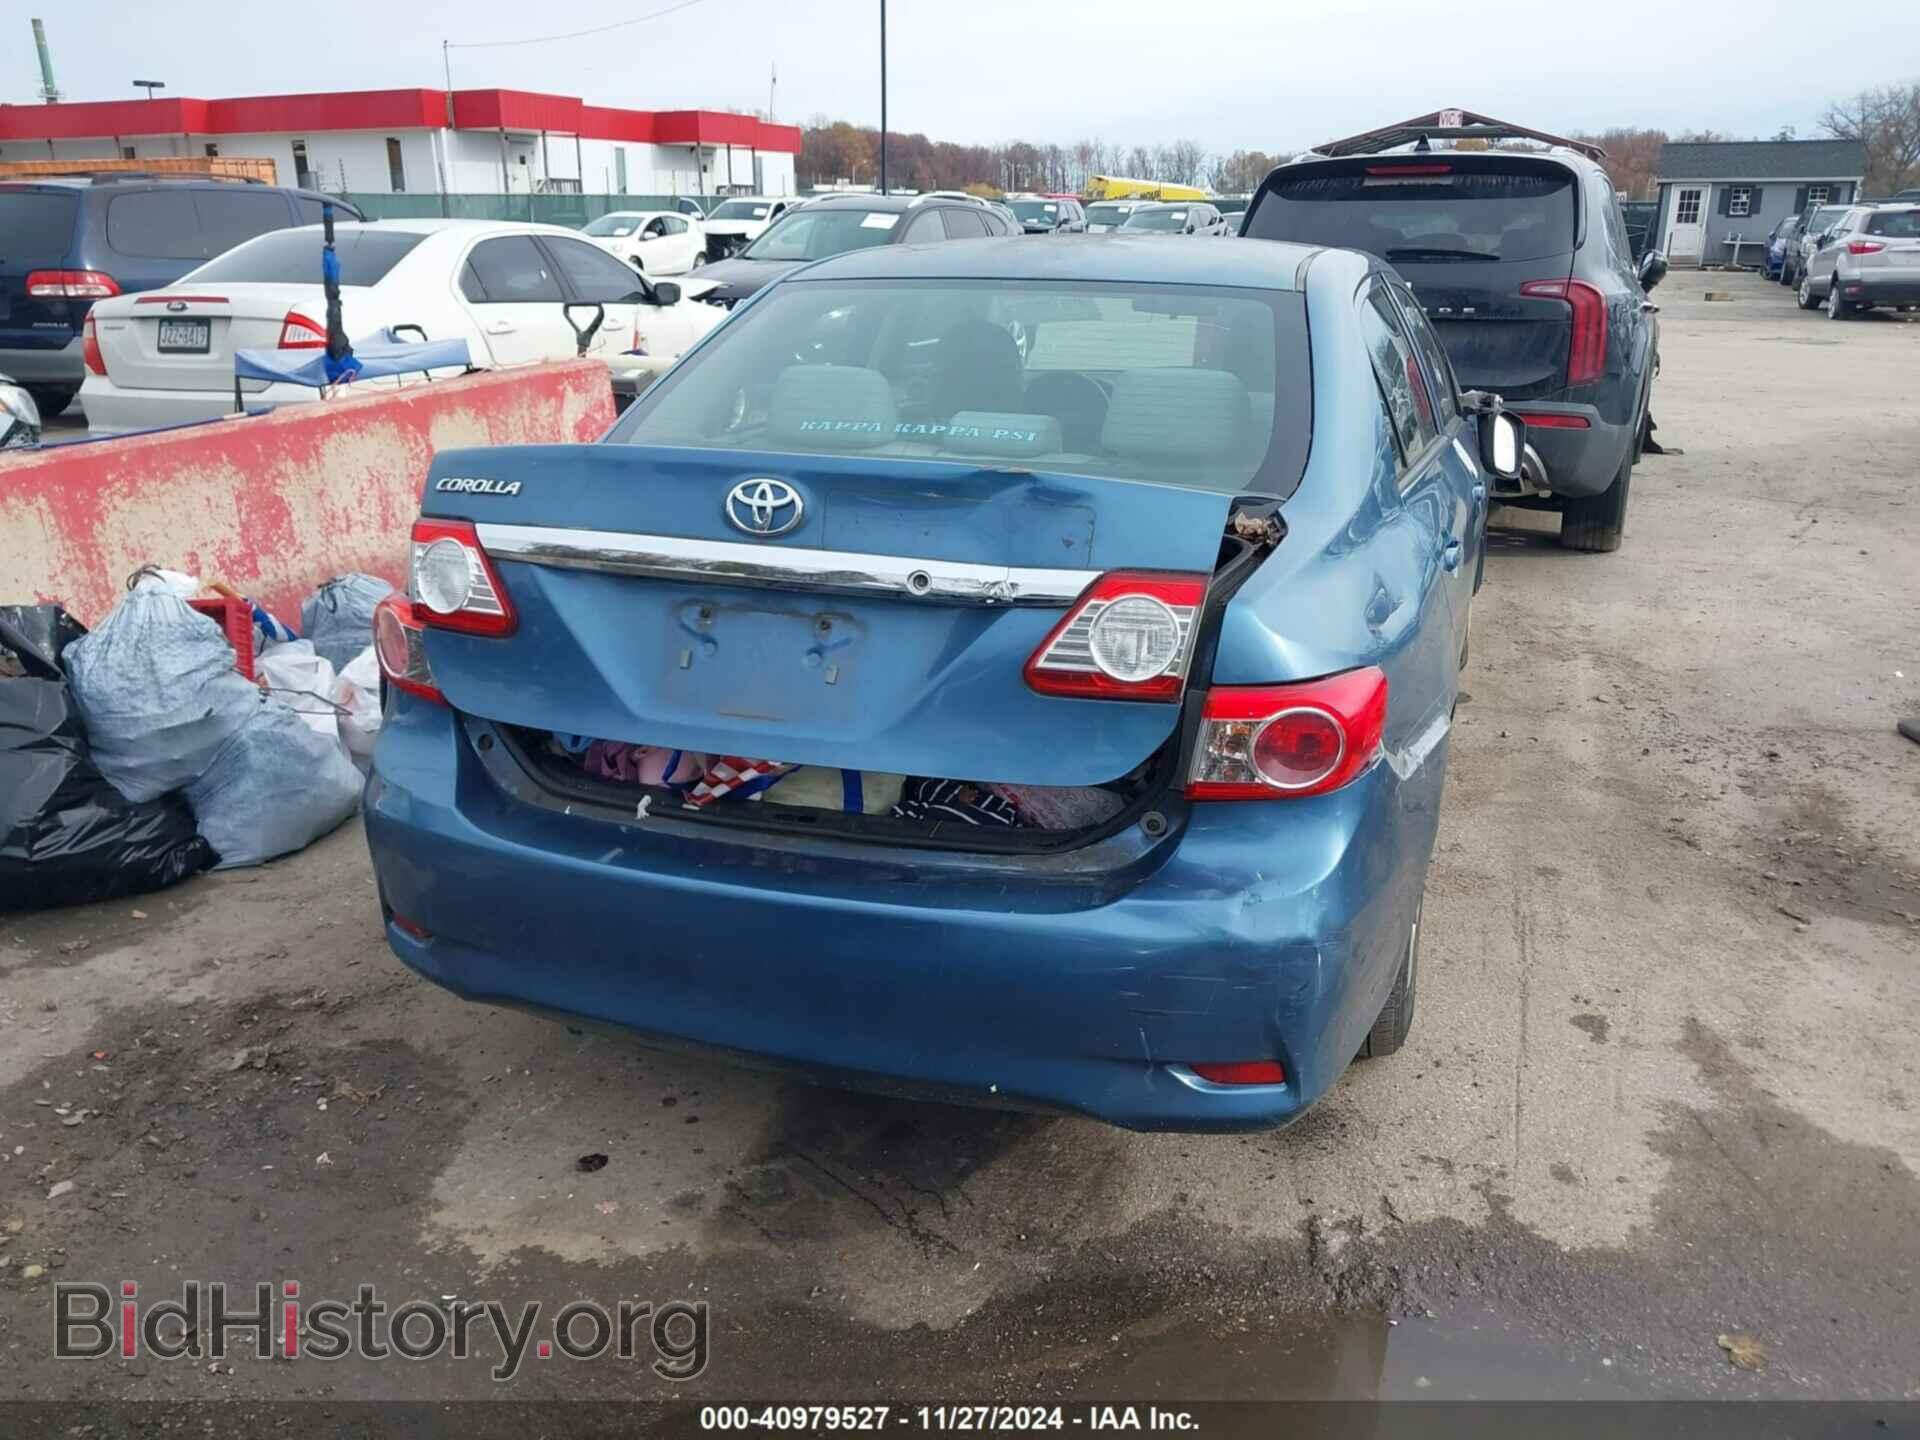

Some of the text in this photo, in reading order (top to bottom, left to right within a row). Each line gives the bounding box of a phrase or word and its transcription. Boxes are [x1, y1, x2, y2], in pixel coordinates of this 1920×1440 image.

[799, 421, 1038, 441] KAPPA KAPPA PSI
[435, 478, 521, 495] COROLLA
